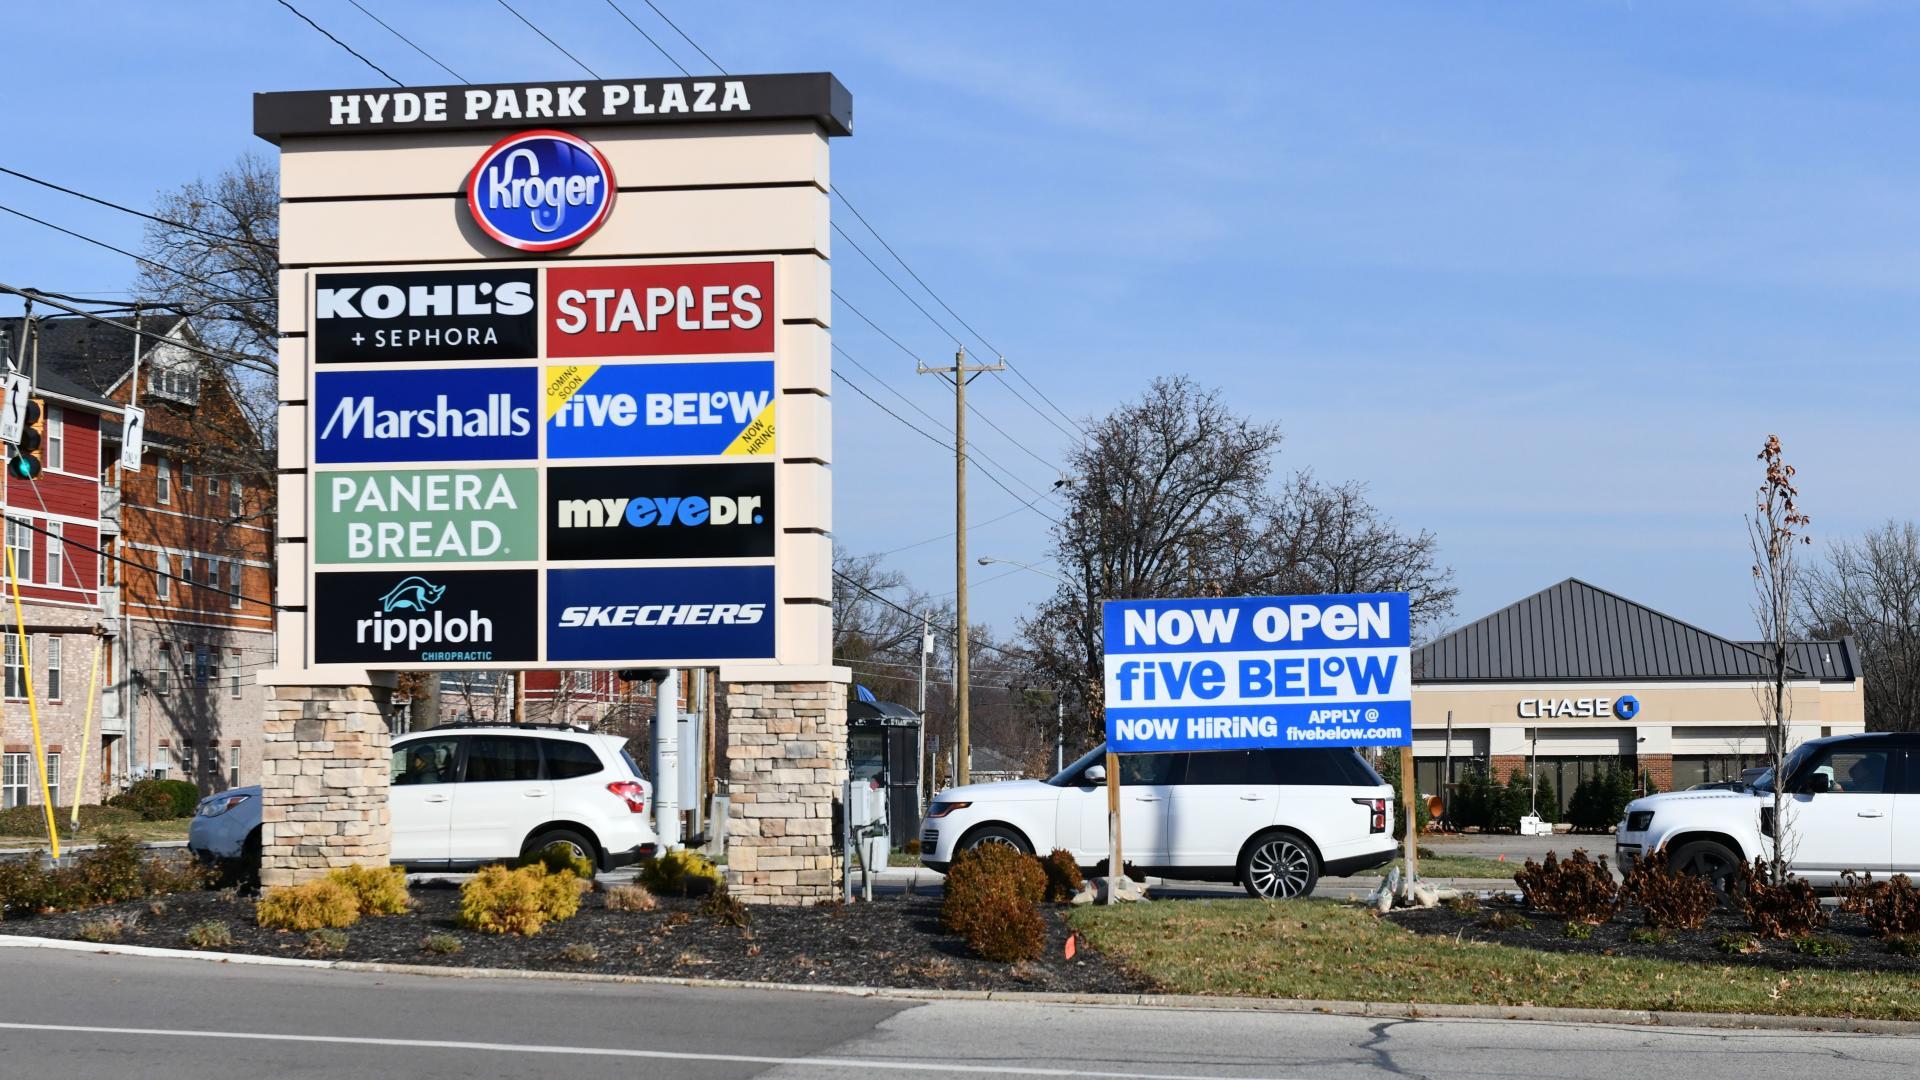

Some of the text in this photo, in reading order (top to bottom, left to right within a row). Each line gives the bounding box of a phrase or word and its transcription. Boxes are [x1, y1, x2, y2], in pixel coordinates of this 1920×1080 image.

[330, 80, 750, 126] HYDE PARK PLAZA
[489, 149, 599, 232] Kroger
[316, 281, 534, 319] KOHL'S
[555, 284, 763, 335] STAPLES
[375, 327, 498, 348] SEPHORA
[546, 366, 578, 397] COMING
[558, 375, 582, 400] SOON
[320, 393, 531, 440] Marshalls
[646, 391, 769, 426] BELOW
[742, 419, 764, 443] NOW
[747, 425, 776, 455] HIRING
[332, 473, 518, 513] PANERA
[356, 609, 493, 651] ripploh
[558, 603, 767, 628] SKECHERS
[1124, 608, 1240, 646] NOW
[421, 651, 493, 661] CHIROPRACTIC
[1238, 655, 1398, 699] BELOW
[1308, 708, 1379, 724] APPLY @
[1519, 697, 1612, 718] CHASE
[1115, 719, 1179, 741] NOW
[1286, 726, 1402, 741] fivebelow.com
